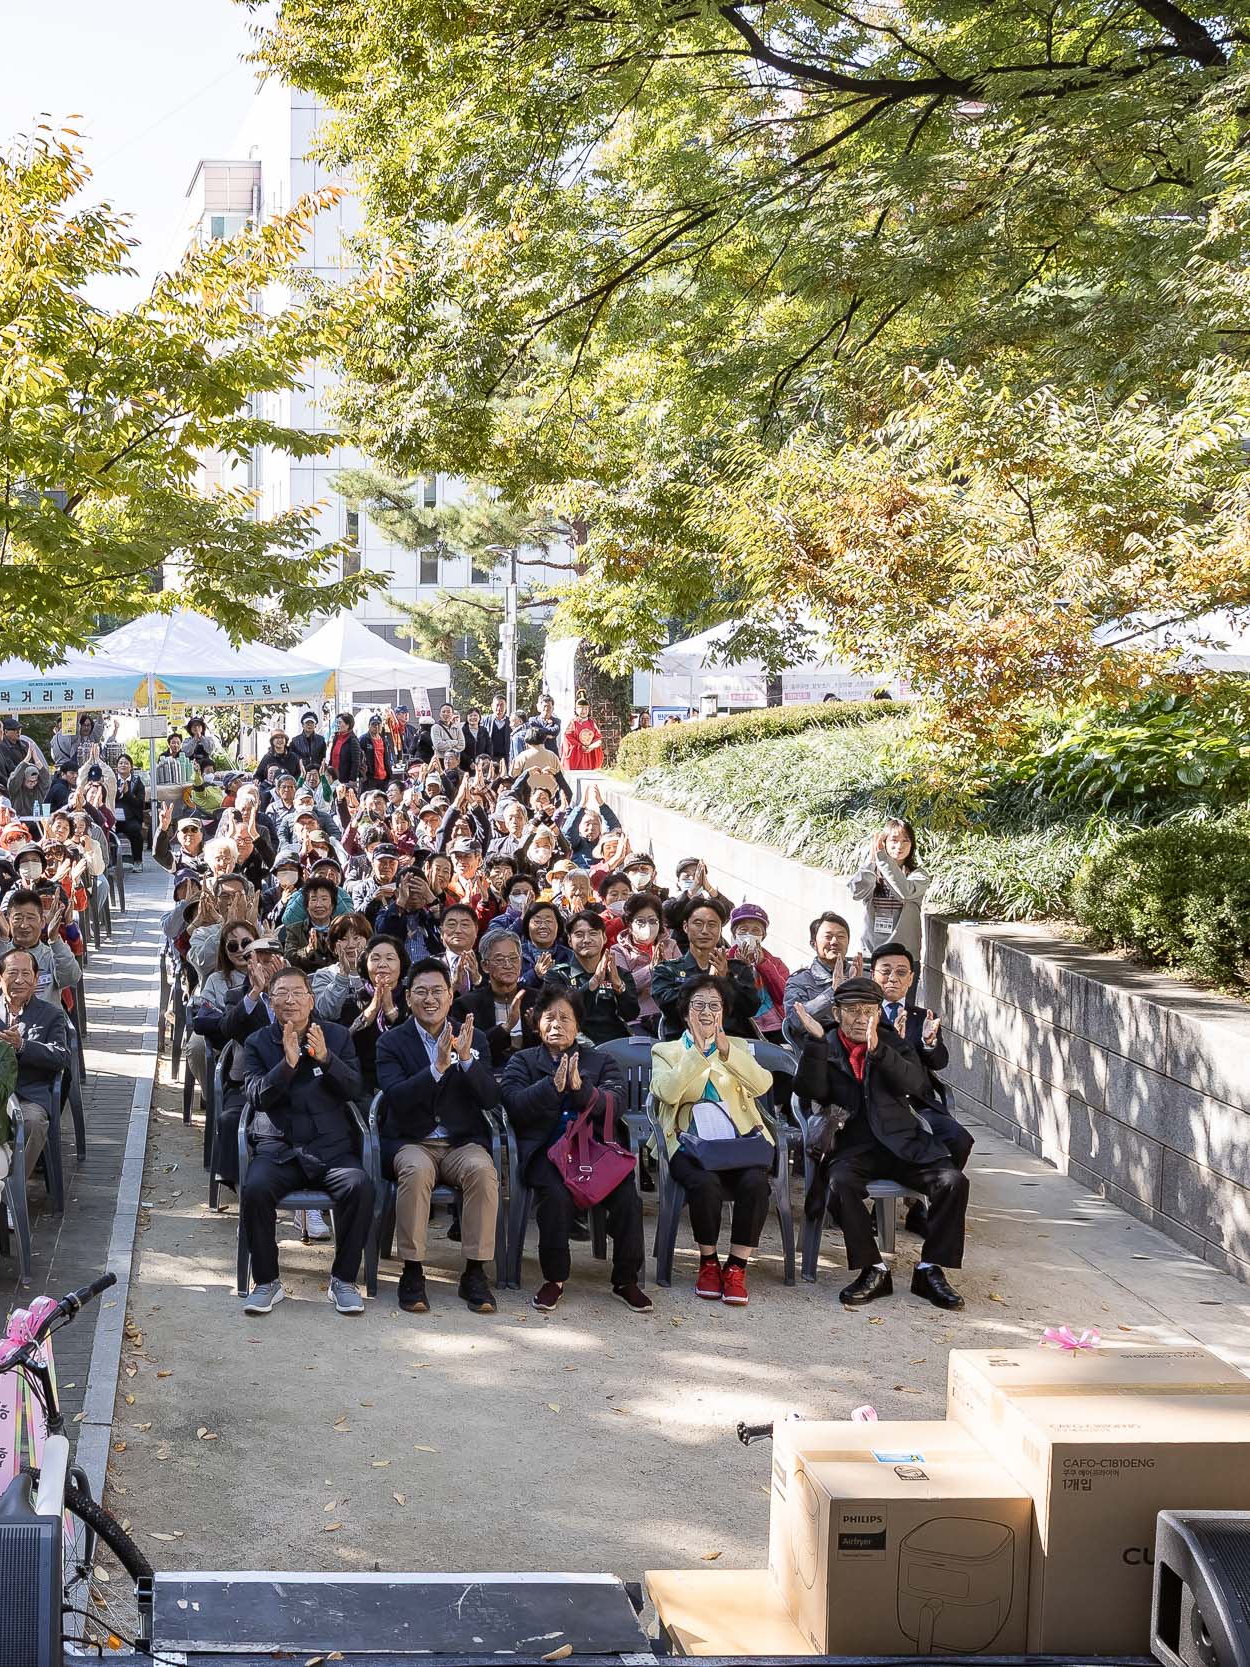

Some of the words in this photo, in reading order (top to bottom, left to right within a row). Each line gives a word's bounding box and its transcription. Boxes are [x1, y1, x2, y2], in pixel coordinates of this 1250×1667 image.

[1062, 1458, 1156, 1469] CAFO-C1810ENG
[1062, 1479, 1093, 1492] 1개입
[842, 1515, 883, 1524] PHILIPS
[842, 1536, 872, 1548] Airfryer
